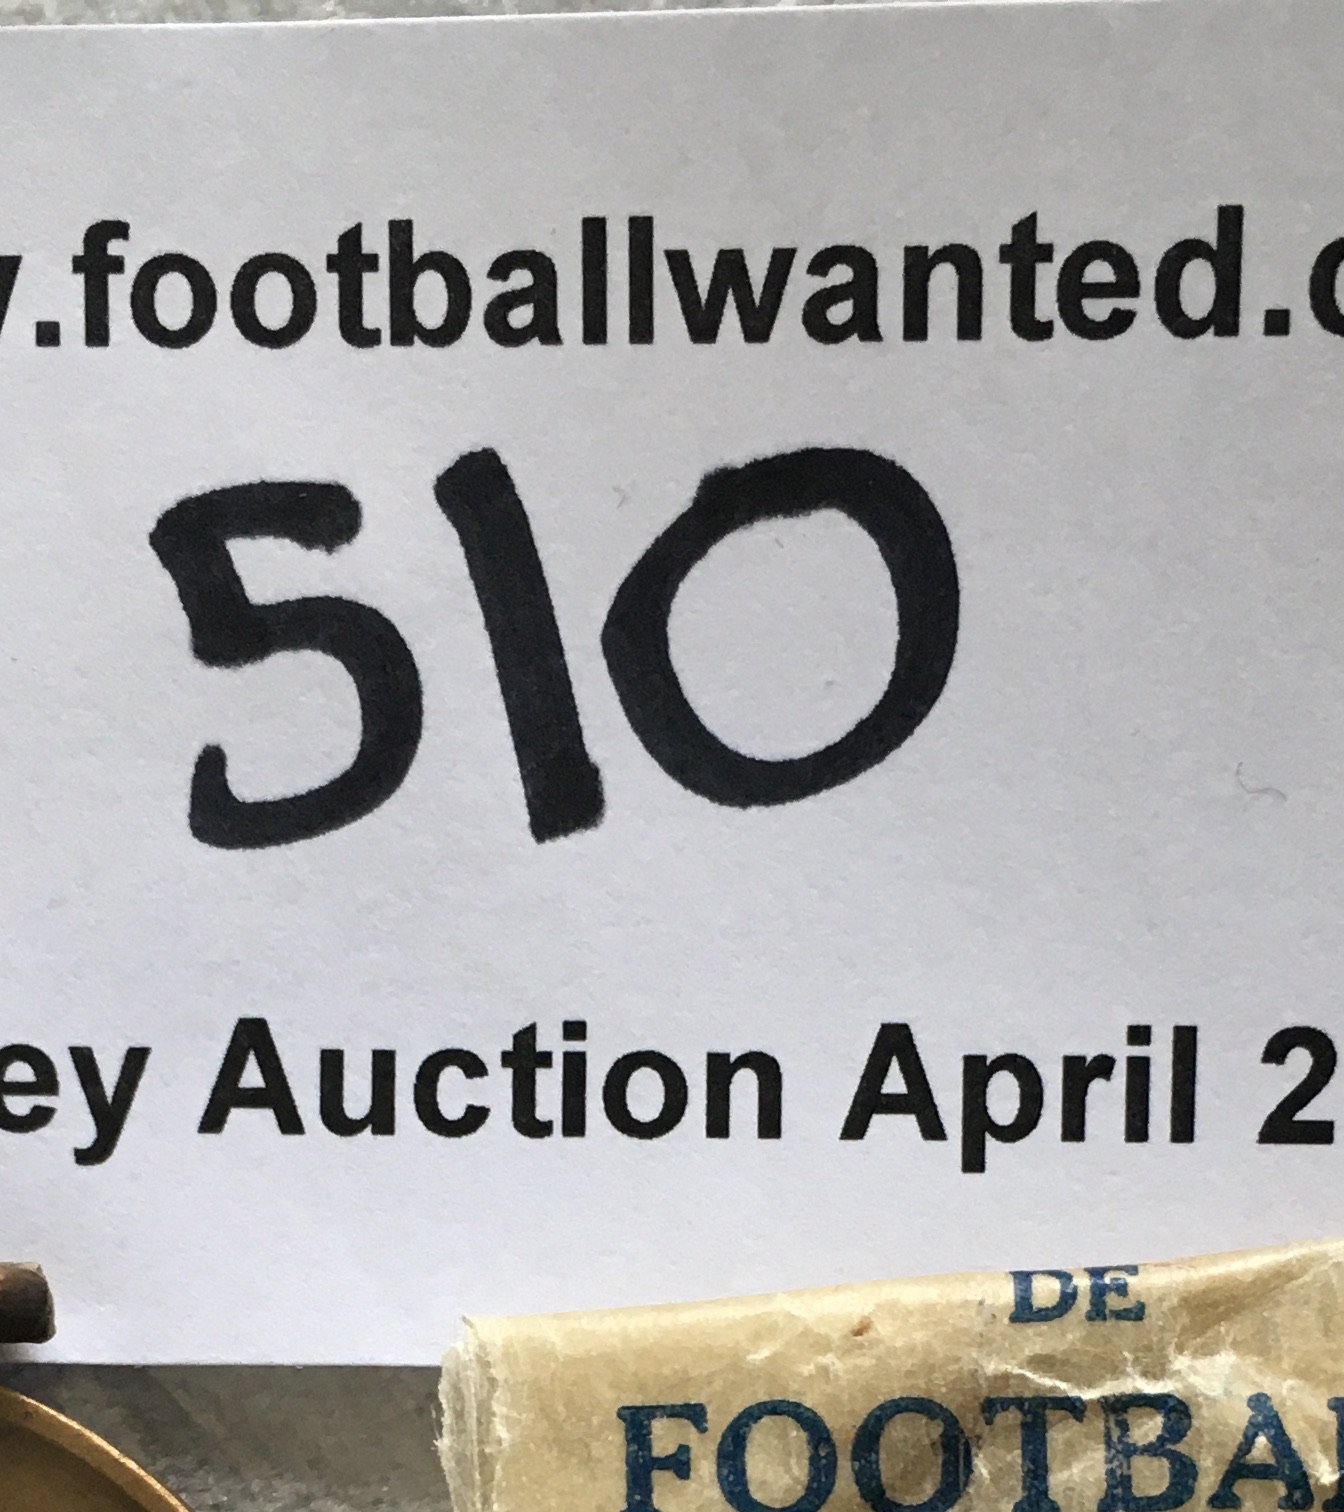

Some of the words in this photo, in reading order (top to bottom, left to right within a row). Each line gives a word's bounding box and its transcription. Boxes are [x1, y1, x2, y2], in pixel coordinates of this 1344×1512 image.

[148, 445, 962, 851] 510
[196, 1016, 784, 1141] Auction
[838, 1021, 1199, 1175] April
[1008, 1263, 1147, 1324] DE
